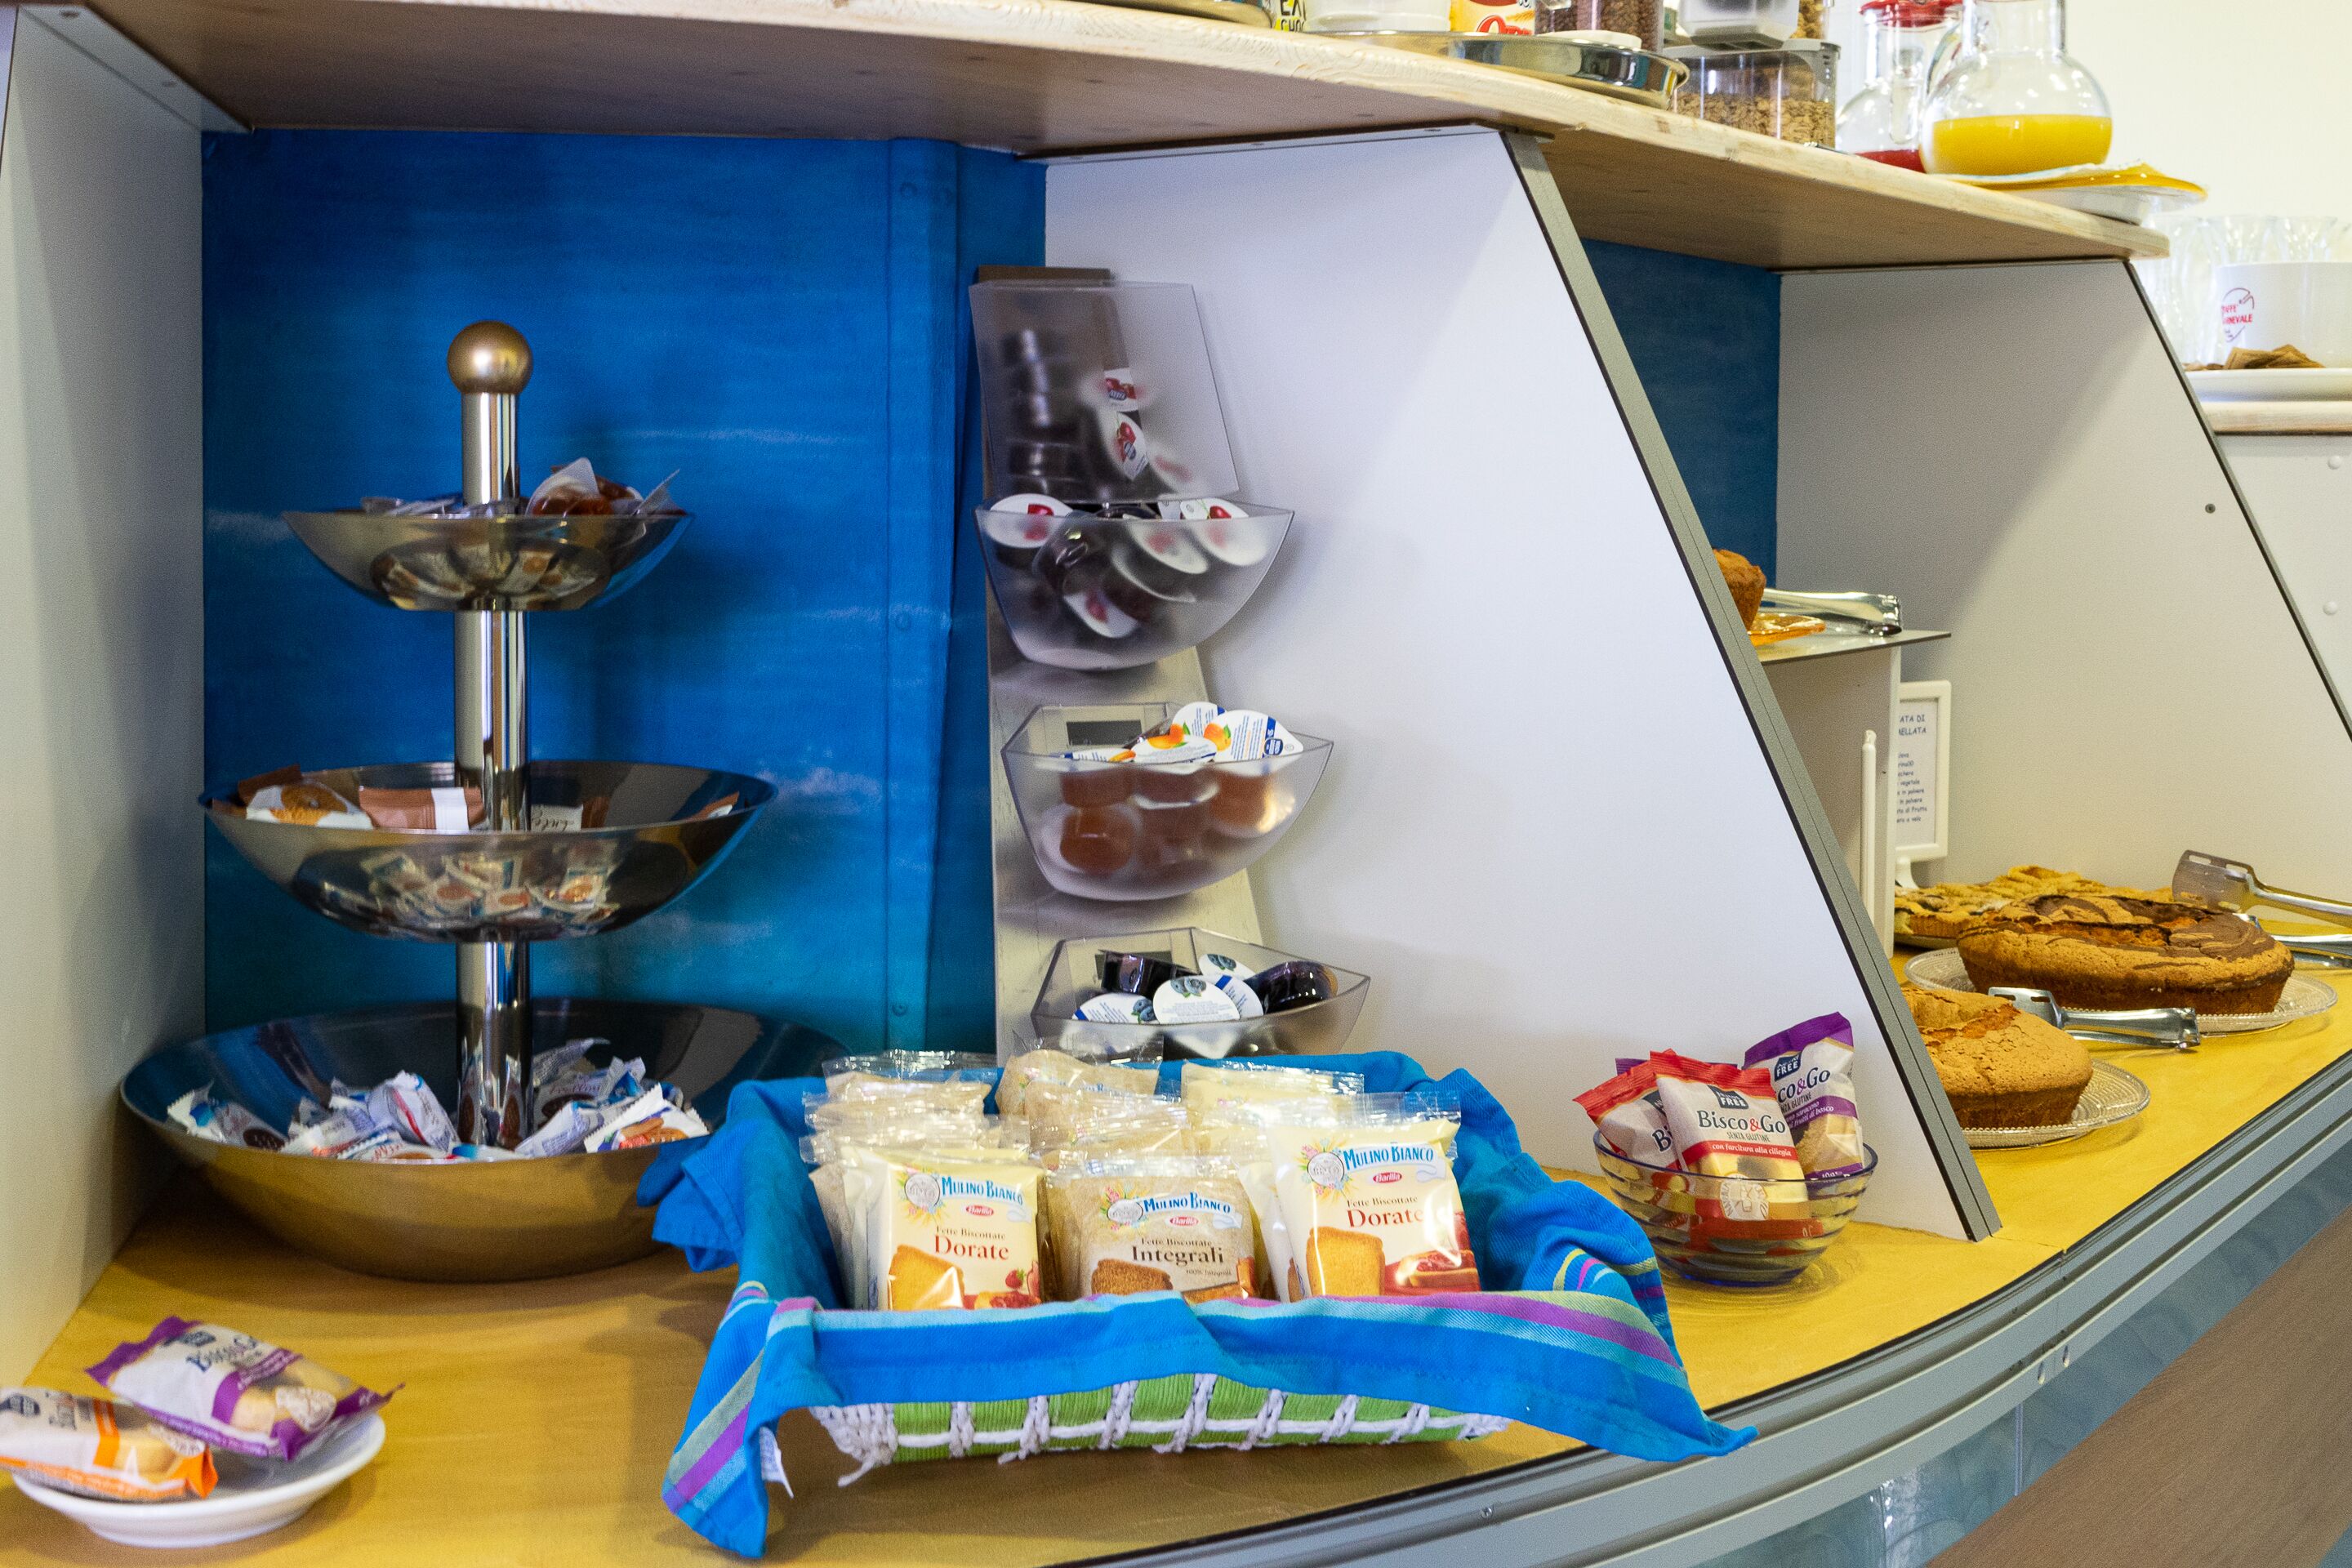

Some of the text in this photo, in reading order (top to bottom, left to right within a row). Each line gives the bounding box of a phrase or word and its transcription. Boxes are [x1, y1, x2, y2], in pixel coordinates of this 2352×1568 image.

[1900, 714, 1925, 723] ATA DI
[1776, 1061, 1799, 1077] FREE
[1777, 1067, 1831, 1102] co&Go
[1720, 1097, 1747, 1107] FREE
[1792, 1091, 1812, 1109] GLUTINE
[1794, 1113, 1809, 1129] frutti
[1815, 1105, 1834, 1116] bosco
[1797, 1101, 1820, 1118] saraceno
[1696, 1109, 1786, 1134] Bisco&Go
[1727, 1131, 1771, 1143] SENZA GLUTINE
[1726, 1143, 1754, 1153] farcitura
[1755, 1146, 1767, 1155] alla
[1769, 1147, 1792, 1157] ciliegia
[1375, 1172, 1401, 1183] Barilla
[1347, 1196, 1418, 1208] Fette Biscottate
[968, 1205, 993, 1216] Barilla
[1171, 1216, 1197, 1226] Barilla
[1348, 1209, 1424, 1228] Dorate
[937, 1226, 1006, 1241] Fette Biscottate
[934, 1235, 1009, 1260] Dorate
[1142, 1237, 1212, 1248] Fette Biscottate
[1132, 1245, 1224, 1267] Integrali
